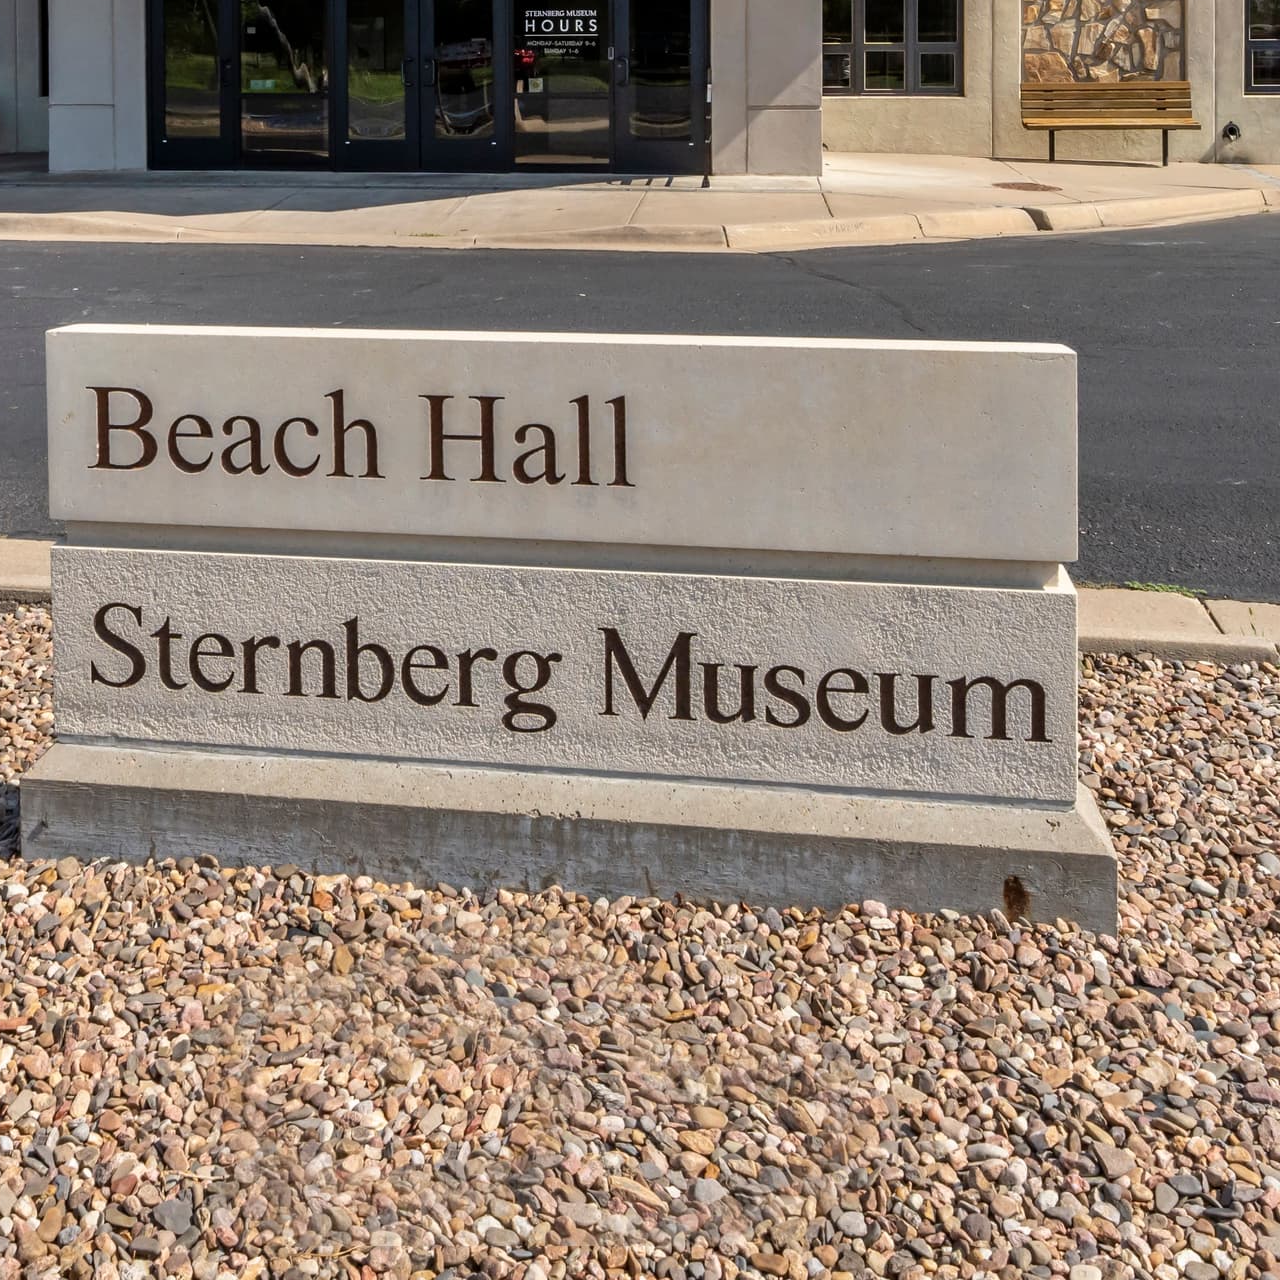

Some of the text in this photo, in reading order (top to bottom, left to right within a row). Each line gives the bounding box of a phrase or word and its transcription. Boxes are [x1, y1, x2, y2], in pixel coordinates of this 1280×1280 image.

[525, 19, 598, 32] HOURS
[566, 9, 597, 17] MUSEUM
[86, 386, 637, 488] Beach Hall
[90, 602, 1054, 744] Sternberg Museum
